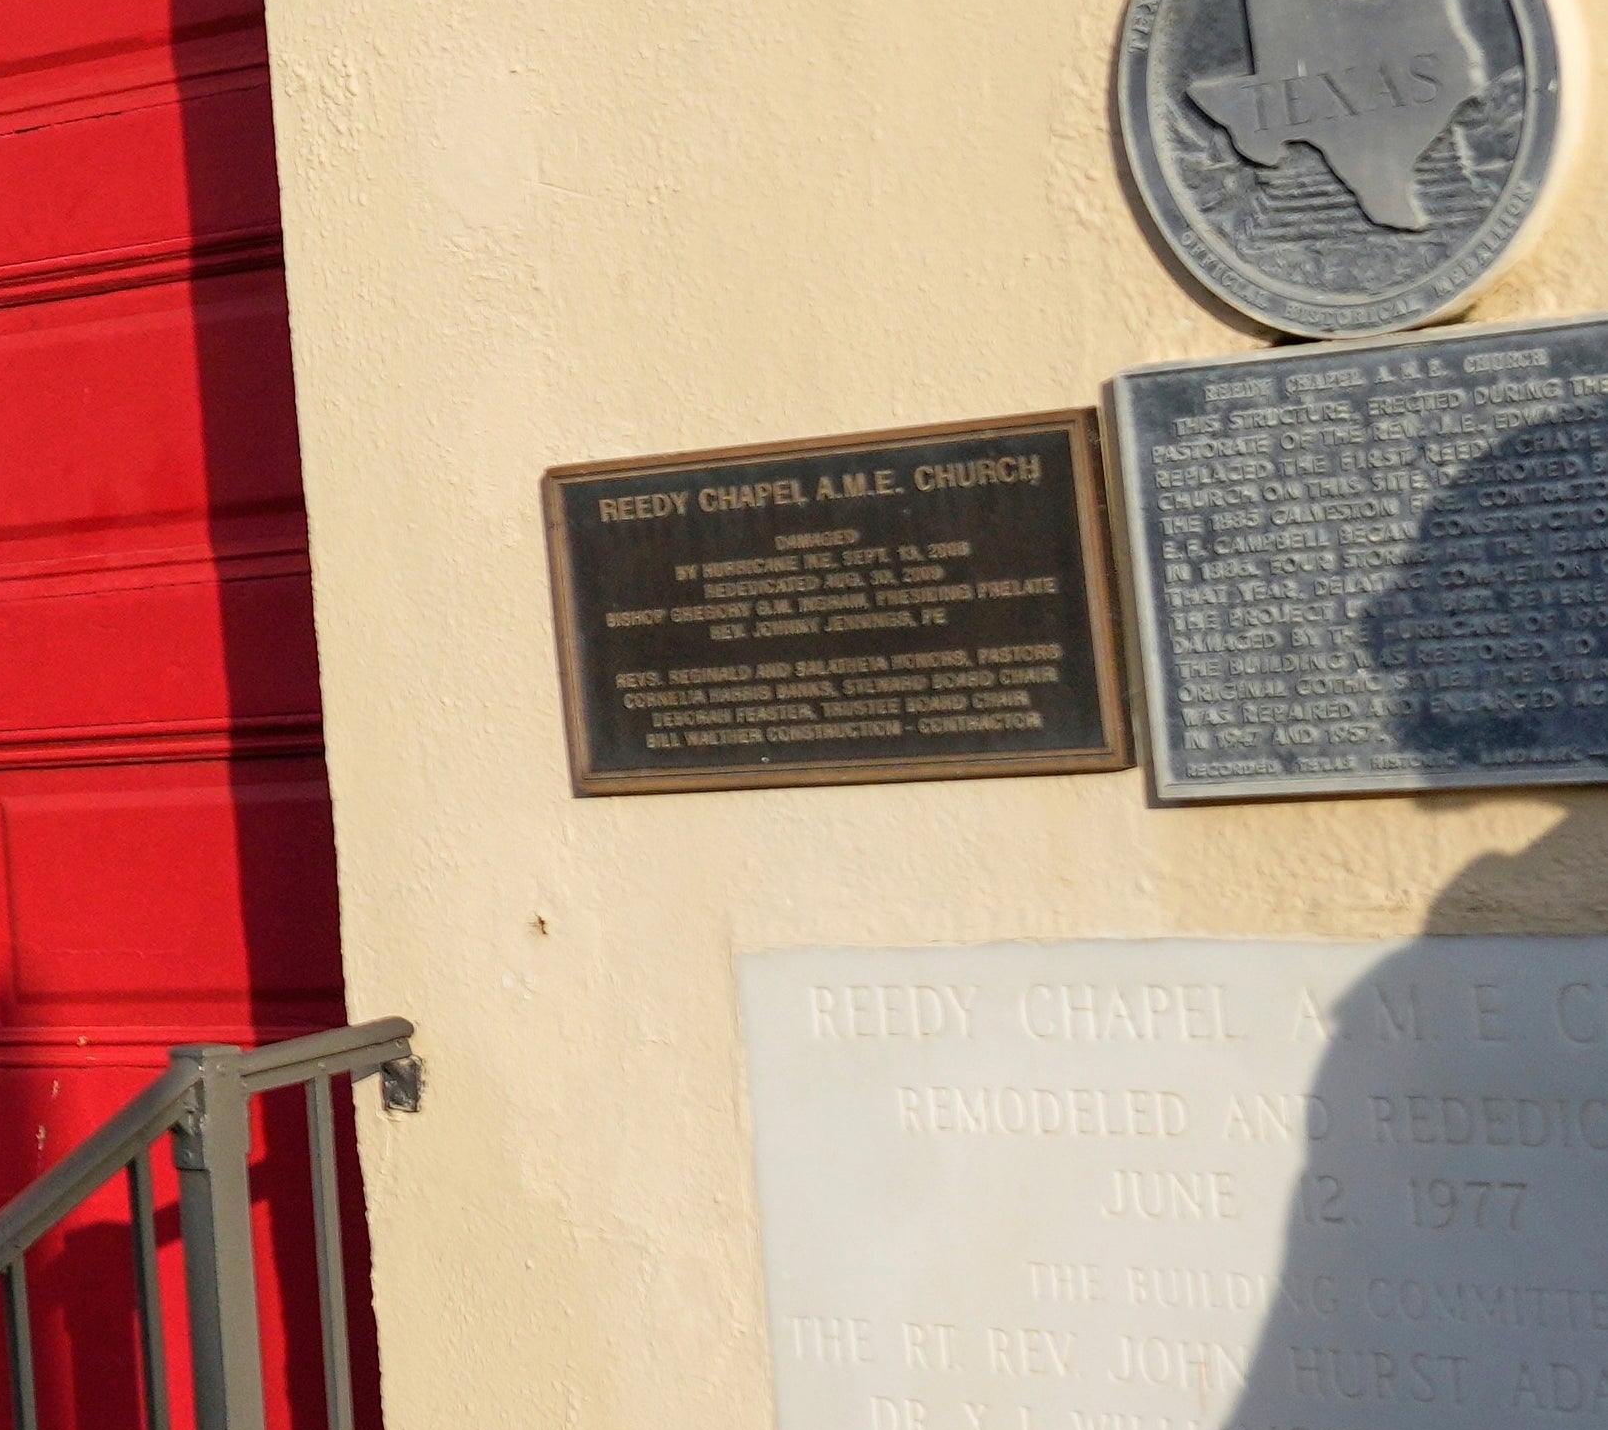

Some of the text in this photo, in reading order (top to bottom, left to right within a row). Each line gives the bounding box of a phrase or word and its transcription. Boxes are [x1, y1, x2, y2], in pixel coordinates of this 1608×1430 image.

[1240, 52, 1442, 133] TEXAS
[1283, 298, 1423, 326] HISTORICAL
[1463, 348, 1550, 374] CHURCH
[1174, 414, 1223, 436] THIS
[1367, 388, 1466, 417] ERECTED
[1474, 377, 1564, 406] DURING
[1151, 434, 1273, 465] PASTORATE
[1280, 428, 1318, 451] OF
[1320, 425, 1366, 447] THE
[1155, 437, 1502, 490] REPLACED THE FIRST REEDY
[598, 453, 1042, 523] REEDY CHAPEL A.M.E. CHURCH
[1157, 486, 1259, 512] CHURCH
[1262, 481, 1304, 502] ON
[1305, 476, 1366, 498] THIS
[1161, 514, 1204, 536] THE
[1270, 495, 1401, 526] GALVESTON
[1213, 527, 1330, 555] CAMPBELL
[1338, 521, 1421, 547] BEGAN
[1164, 562, 1192, 583] IN
[1270, 551, 1337, 576] FOUR
[975, 576, 1058, 600] PRELATE
[1165, 585, 1229, 608] THAT
[1172, 610, 1221, 632] THE
[1228, 602, 1337, 628] PROJECT
[1173, 630, 1283, 655] DAMAGED
[1291, 626, 1323, 649] BY
[1328, 623, 1370, 646] THE
[668, 664, 754, 685] REGINALD
[755, 661, 794, 680] AND
[976, 641, 1064, 664] PASTORS
[1176, 659, 1221, 680] THE
[1228, 651, 1350, 676] BUILDING
[1415, 638, 1549, 664] RESTORED
[624, 688, 708, 709] CORNELIA
[1178, 681, 1288, 704] ORIGINAL
[1295, 673, 1383, 696] GOTHIC
[1181, 687, 1560, 727] WAS REPAIRED AND ENLARGED
[646, 731, 683, 748] BILL
[766, 720, 903, 743] CONSTRUCTION
[917, 709, 1045, 734] CONTRACTOR
[651, 707, 733, 728] DEBORAH
[820, 697, 901, 717] TRUSTEE
[1184, 729, 1210, 750] IN
[1273, 723, 1321, 746] AND
[1185, 759, 1283, 779] RECORDED
[1295, 754, 1358, 773] TEXAS
[809, 983, 982, 1041] REEDY
[1019, 982, 1250, 1043] CHAPEL
[896, 1084, 1190, 1137] REMODELED
[1224, 1092, 1330, 1142] AND
[1100, 1169, 1528, 1231] JUNE 1977
[1025, 1260, 1106, 1302] THE
[1126, 1266, 1340, 1317] BUILDING
[782, 1314, 1471, 1405] THE RT. REV. JOHN HURST
